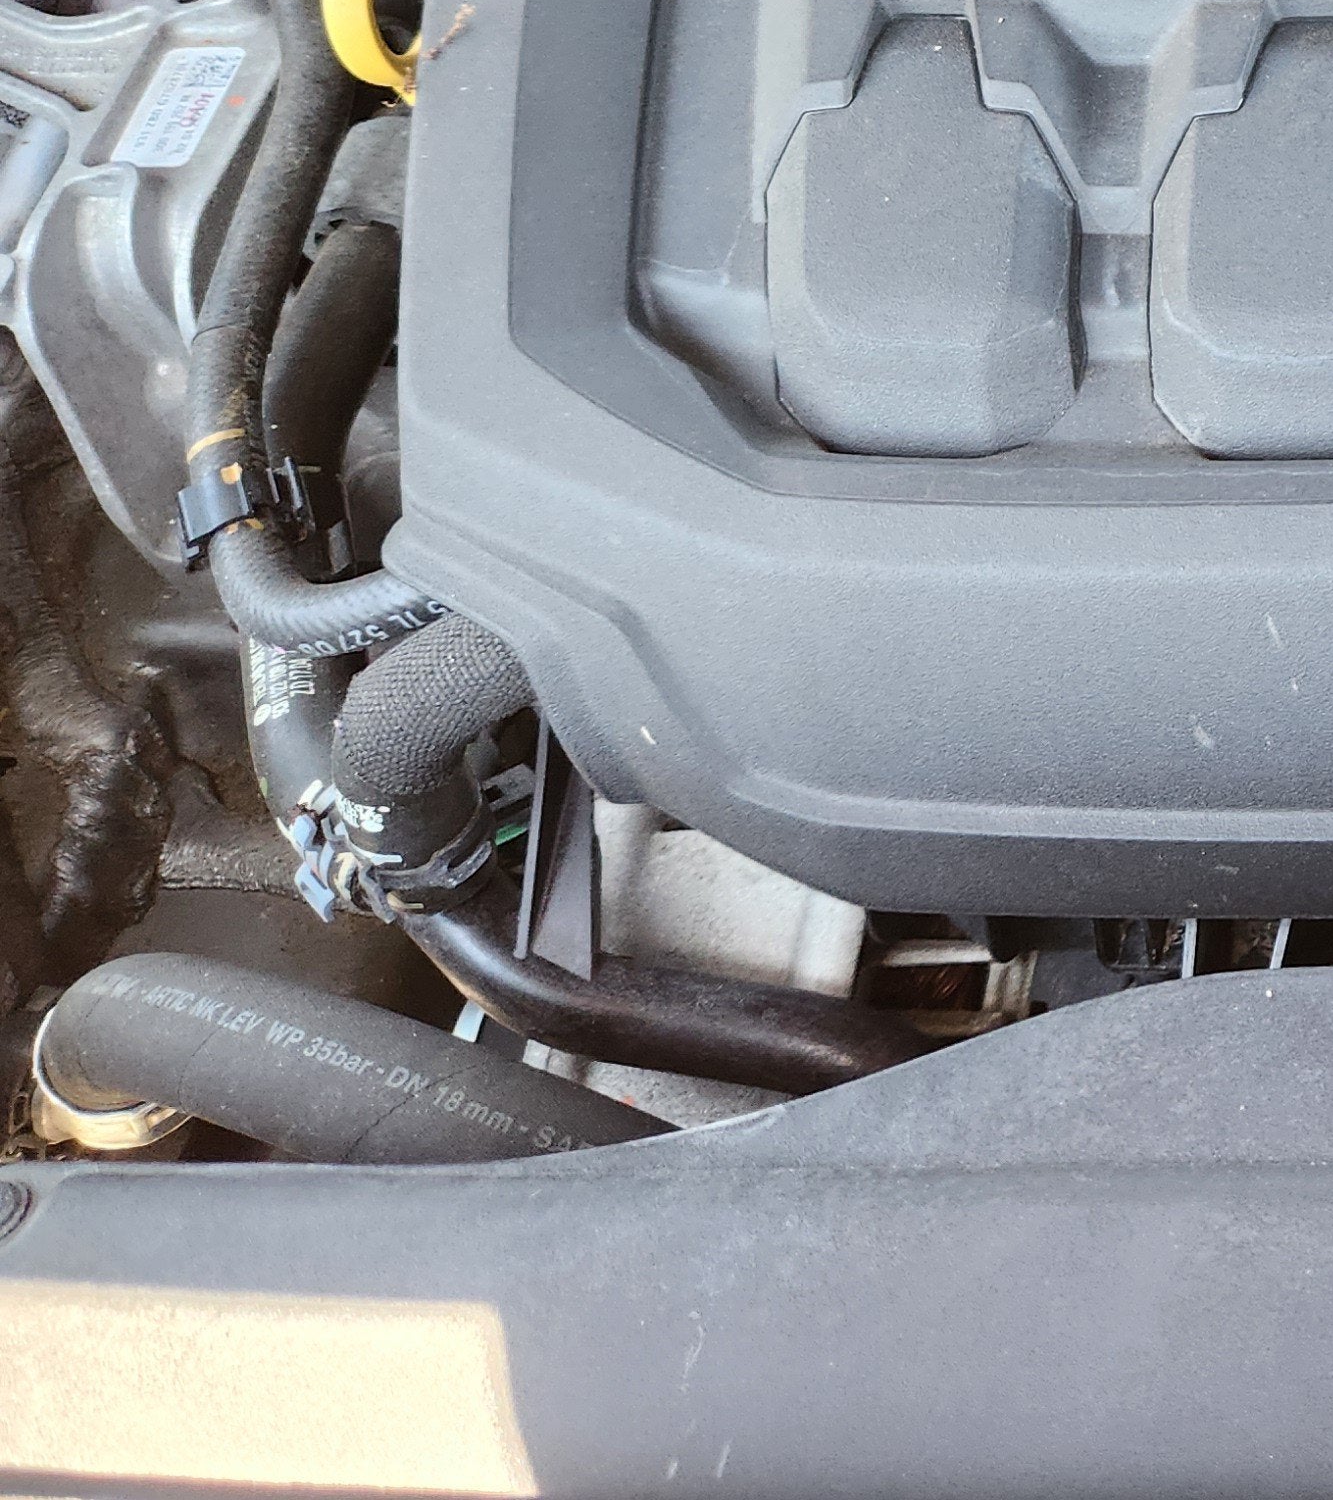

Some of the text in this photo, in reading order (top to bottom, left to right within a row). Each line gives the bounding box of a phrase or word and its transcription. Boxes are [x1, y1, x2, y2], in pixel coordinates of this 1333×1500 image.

[266, 1020, 306, 1047] WP
[304, 1035, 375, 1076] 35bar
[384, 1065, 430, 1096] DN
